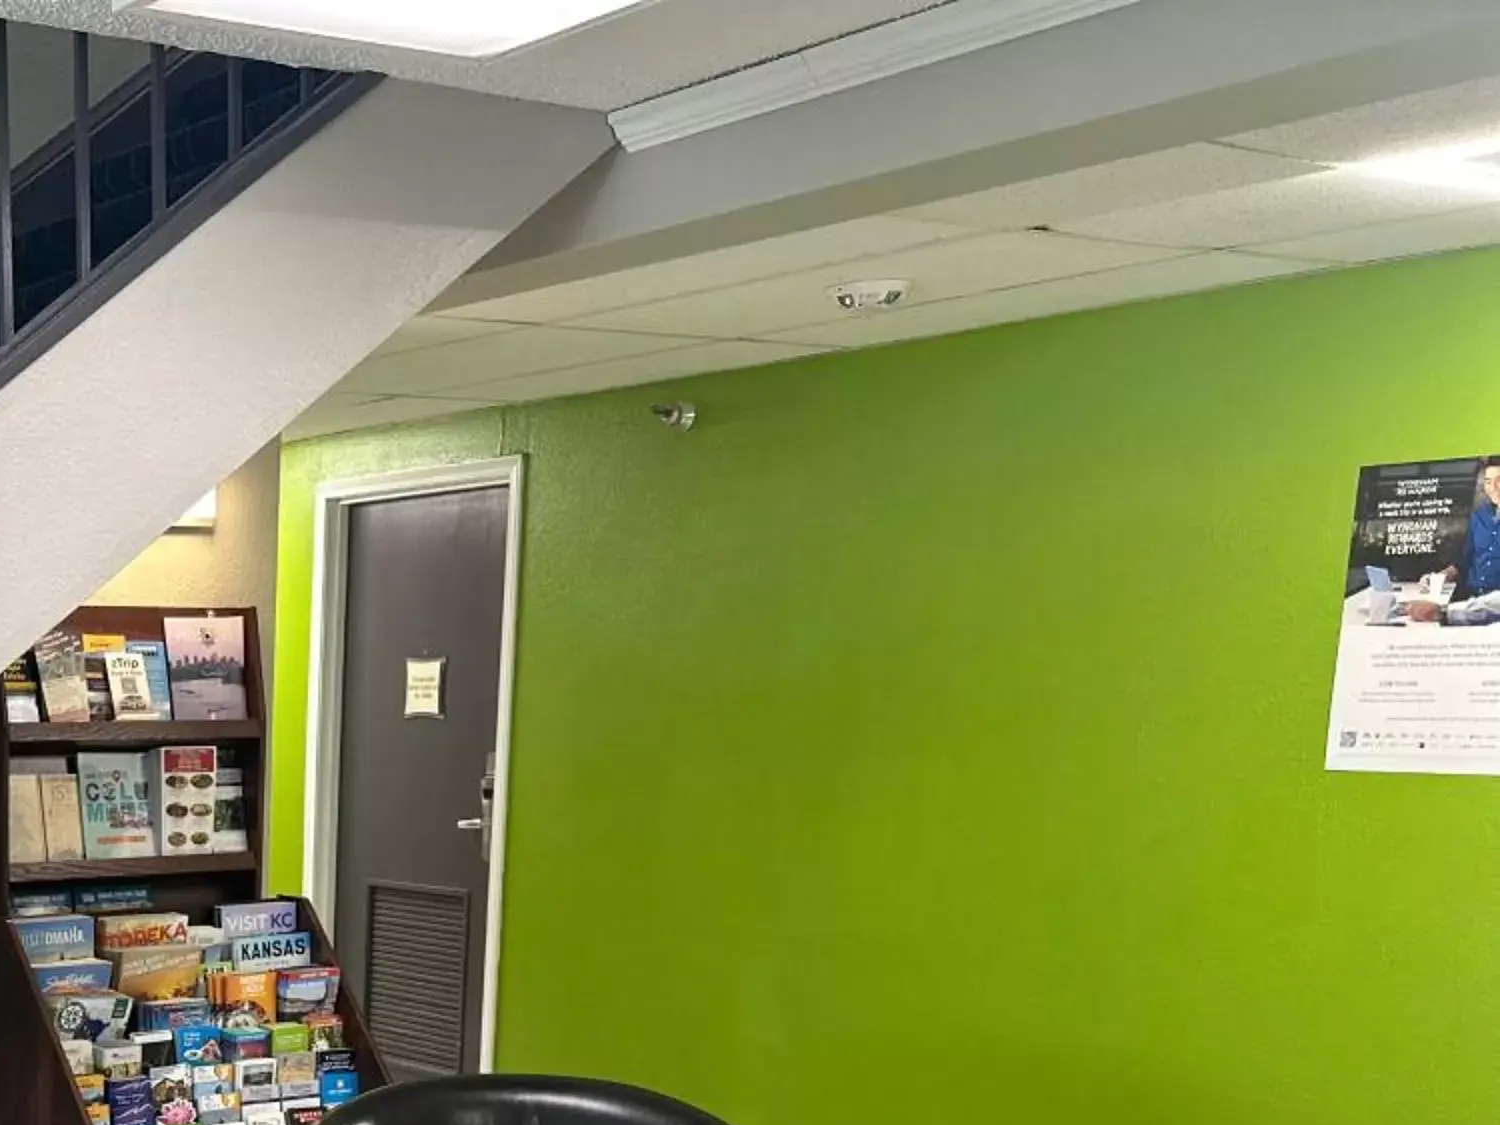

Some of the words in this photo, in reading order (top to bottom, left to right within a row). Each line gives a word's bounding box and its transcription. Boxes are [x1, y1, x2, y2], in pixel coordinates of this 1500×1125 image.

[225, 913, 268, 931] VISIT
[270, 911, 294, 929] KC
[241, 937, 306, 961] KANSAS
